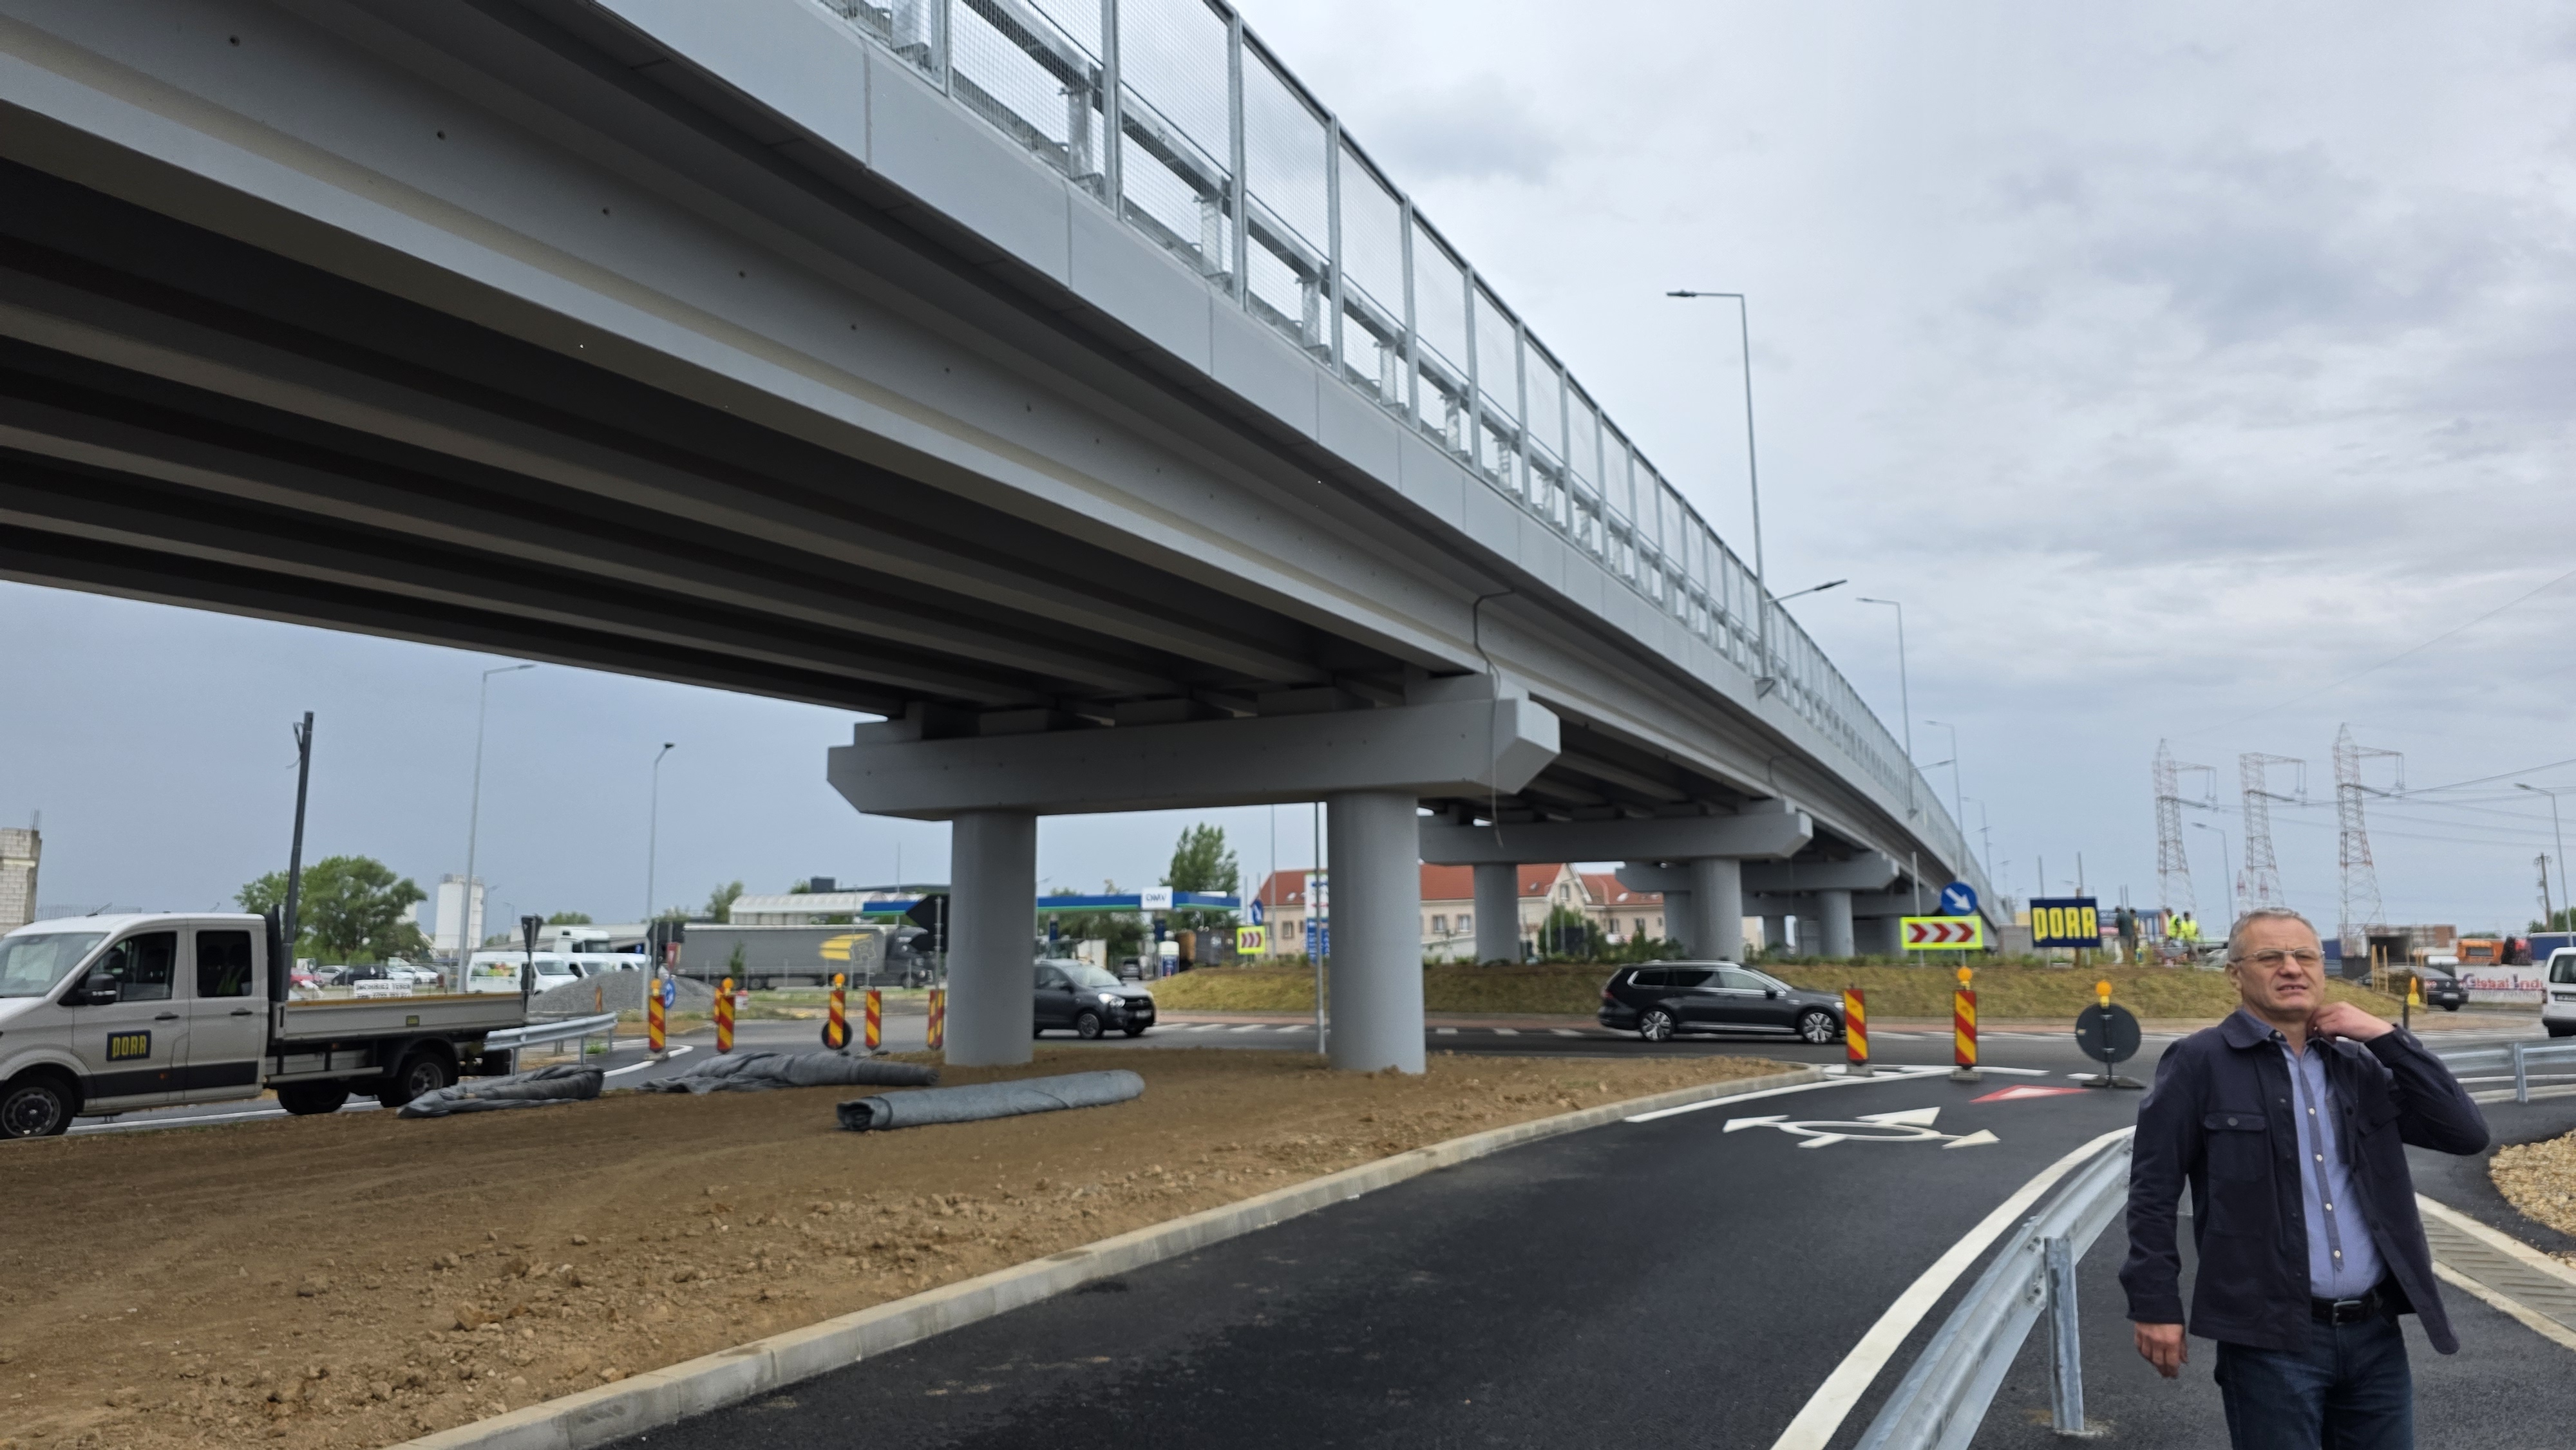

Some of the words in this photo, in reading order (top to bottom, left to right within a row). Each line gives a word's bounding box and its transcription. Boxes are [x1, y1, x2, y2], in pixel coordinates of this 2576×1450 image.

[1146, 893, 1167, 902] OMV
[2032, 907, 2098, 942] PORR
[2461, 973, 2509, 989] Global
[112, 1034, 147, 1059] PORR
